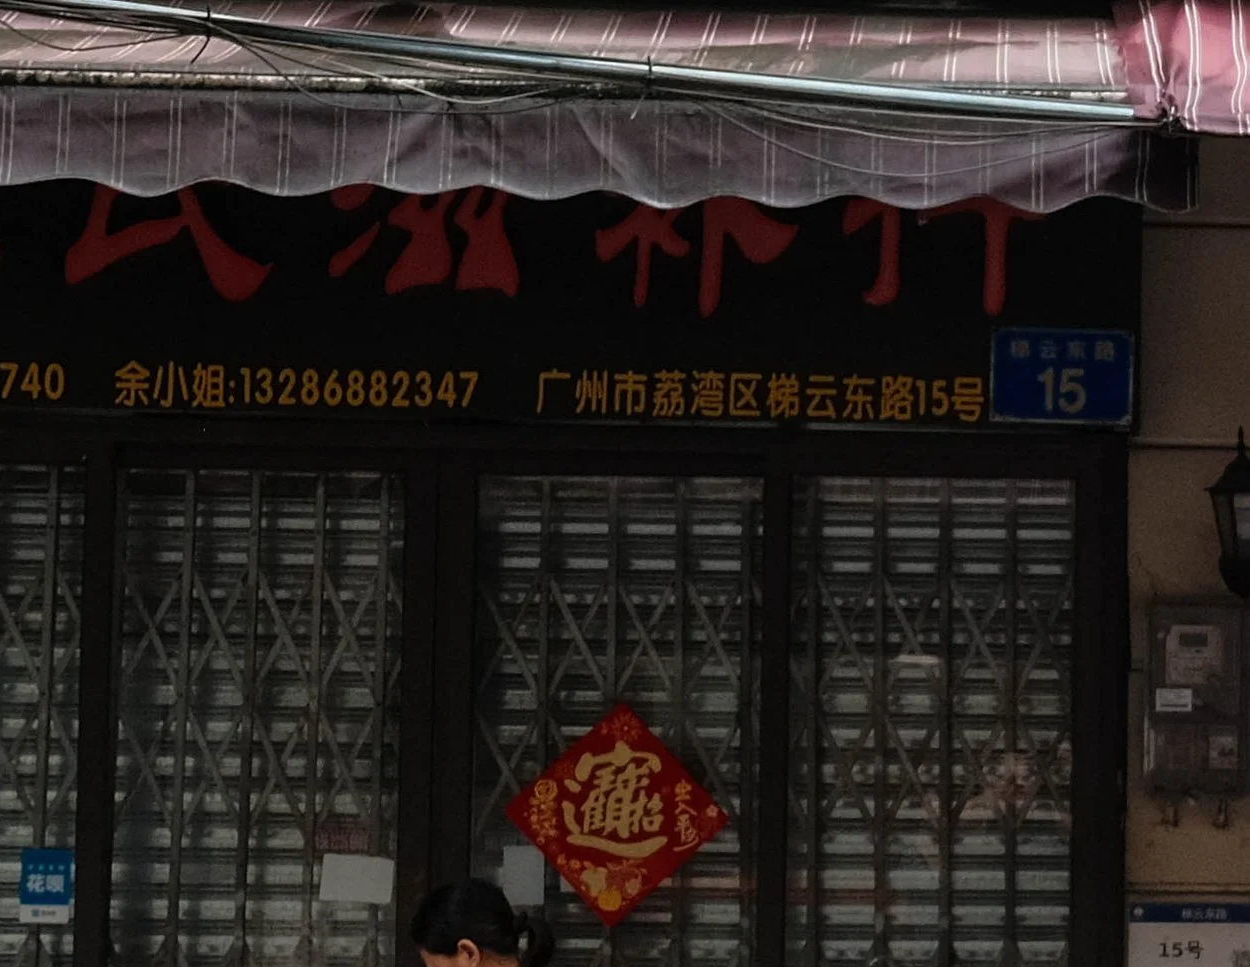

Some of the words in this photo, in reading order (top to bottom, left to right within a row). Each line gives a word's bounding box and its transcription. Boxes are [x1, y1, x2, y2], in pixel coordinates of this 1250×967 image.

[536, 368, 985, 422] 广州市荔湾区梯云东路15号
[1036, 366, 1087, 415] 15
[1159, 940, 1203, 959] 15号
